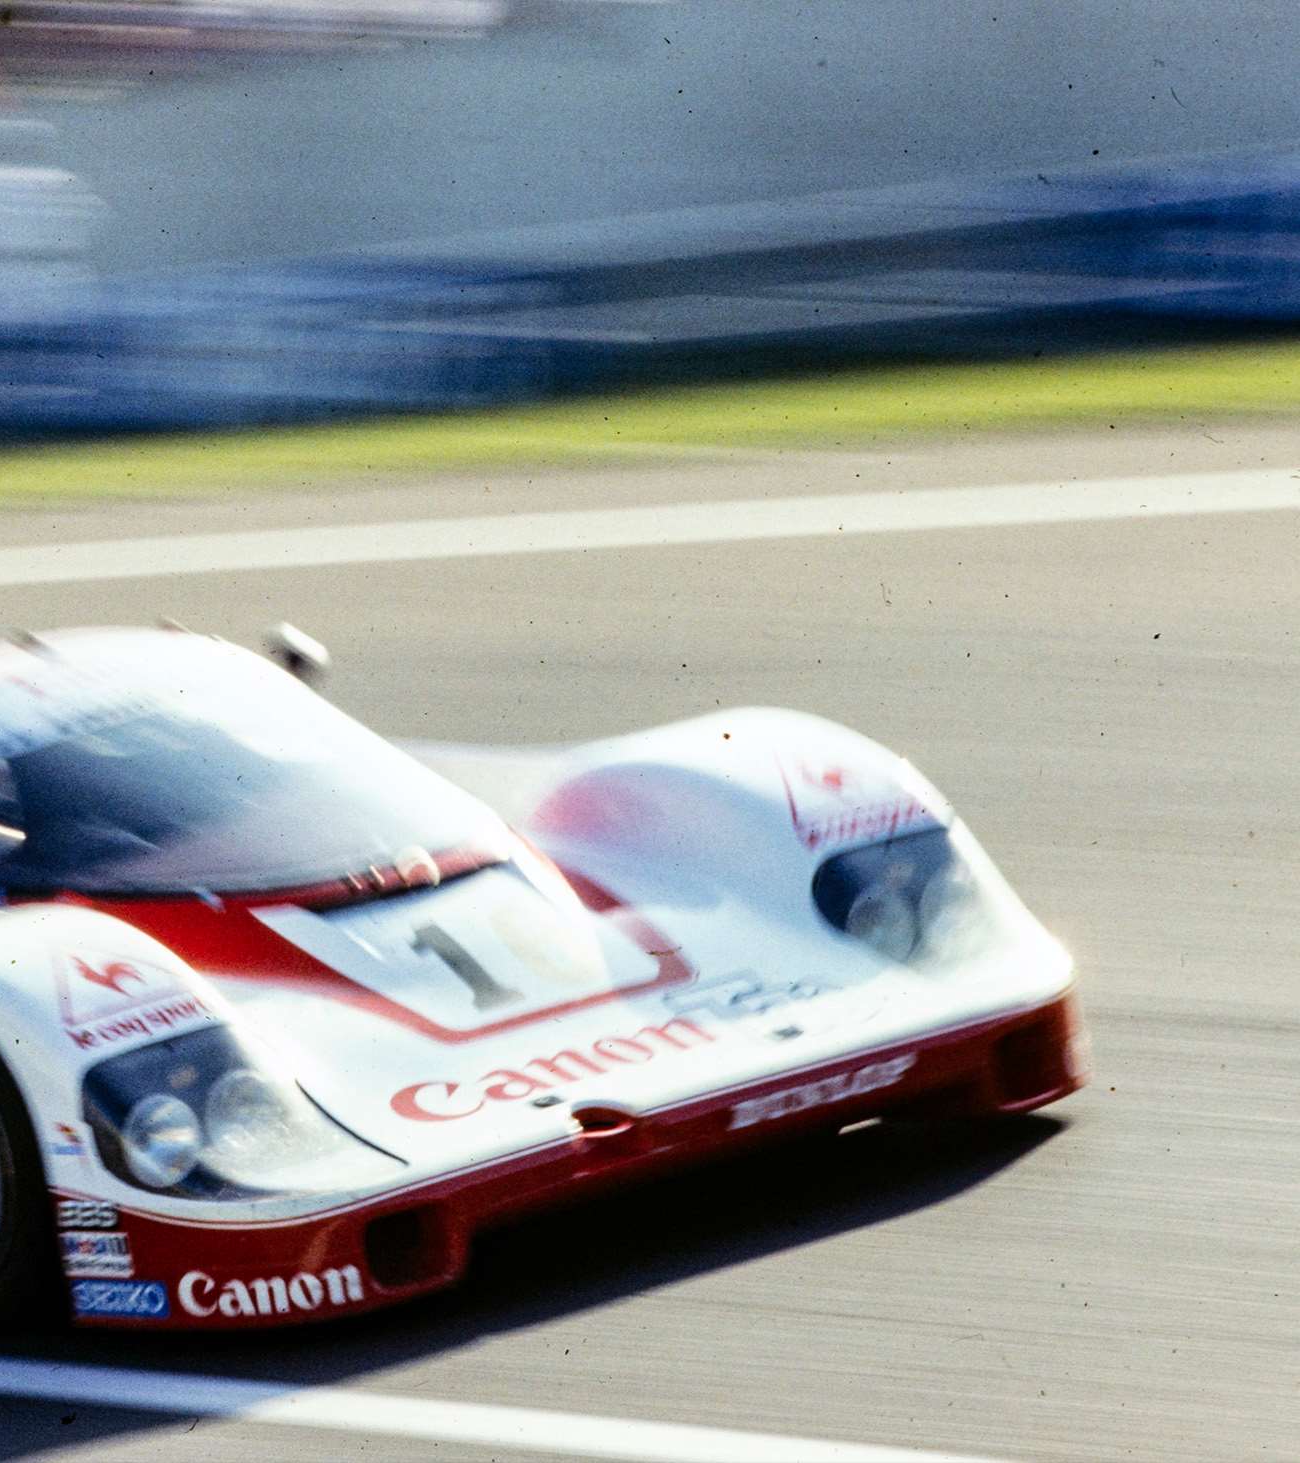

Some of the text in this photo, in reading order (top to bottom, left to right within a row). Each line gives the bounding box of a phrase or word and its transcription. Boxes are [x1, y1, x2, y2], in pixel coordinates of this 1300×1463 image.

[409, 921, 522, 1012] 1
[390, 1017, 717, 1122] Canon
[178, 1263, 364, 1318] Canon
